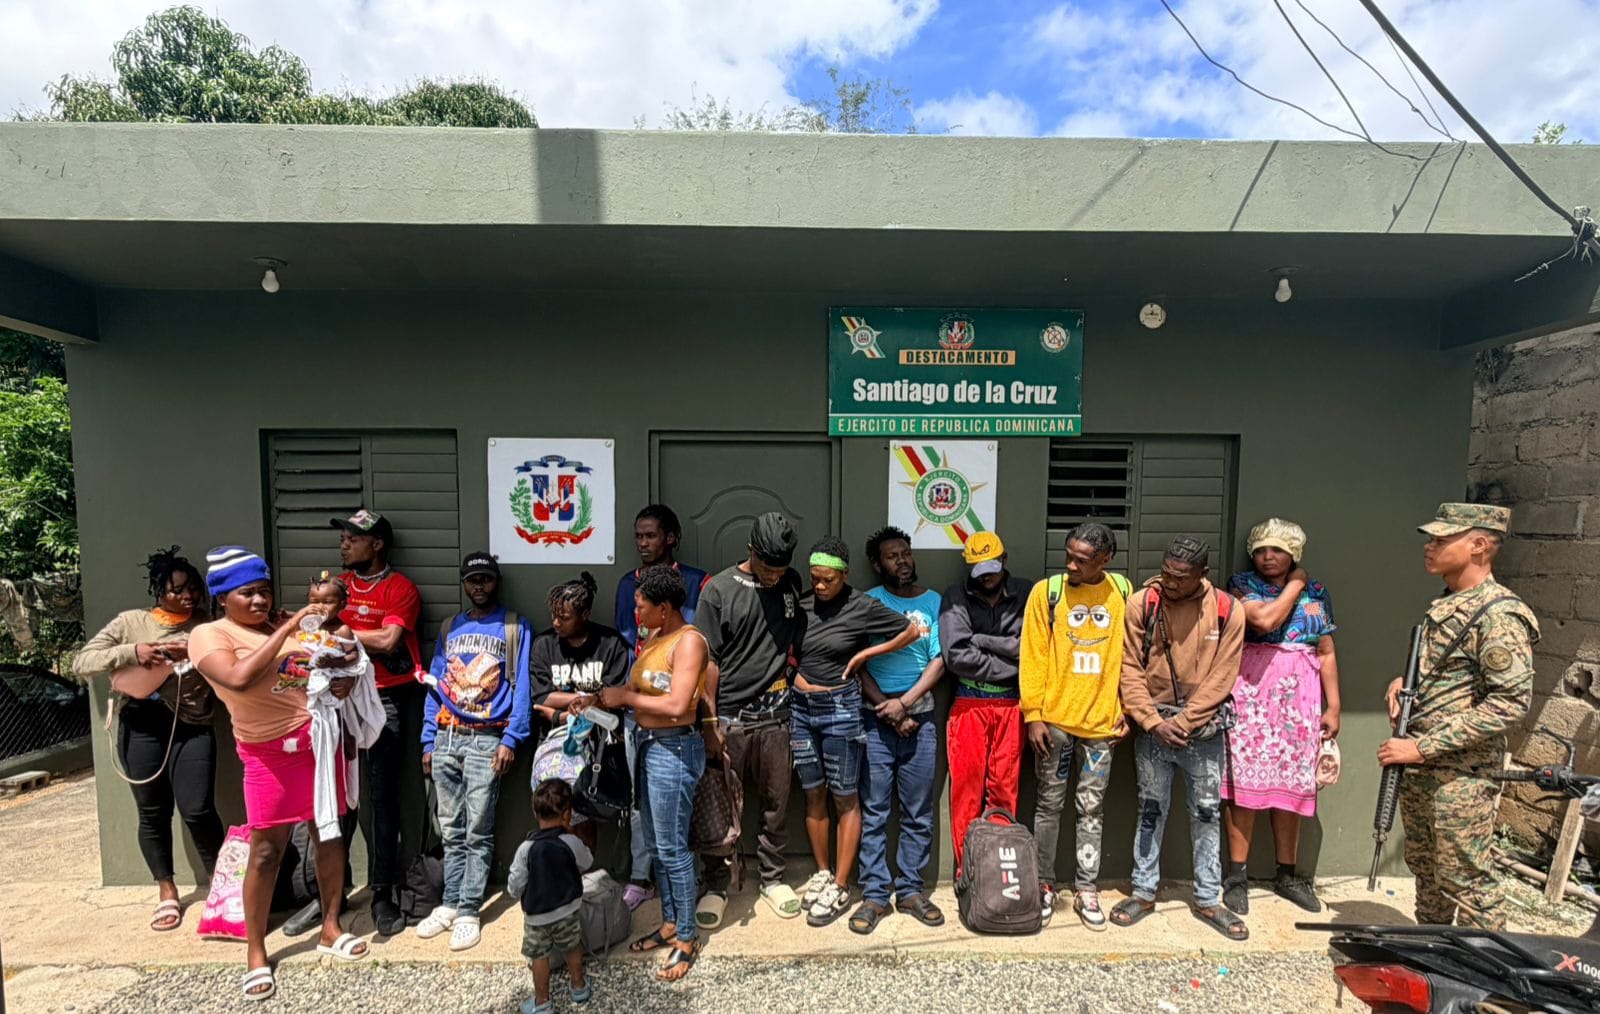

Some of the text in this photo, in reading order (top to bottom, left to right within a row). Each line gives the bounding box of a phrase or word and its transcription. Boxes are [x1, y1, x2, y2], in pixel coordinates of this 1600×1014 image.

[906, 351, 1008, 365] DESTACAMENTO
[853, 378, 1057, 405] Santiago de la Cruz
[838, 418, 1075, 433] EJERCITO DE REPUBLICA DOMINICANA
[1072, 650, 1101, 674] m
[999, 847, 1021, 901] AFIE
